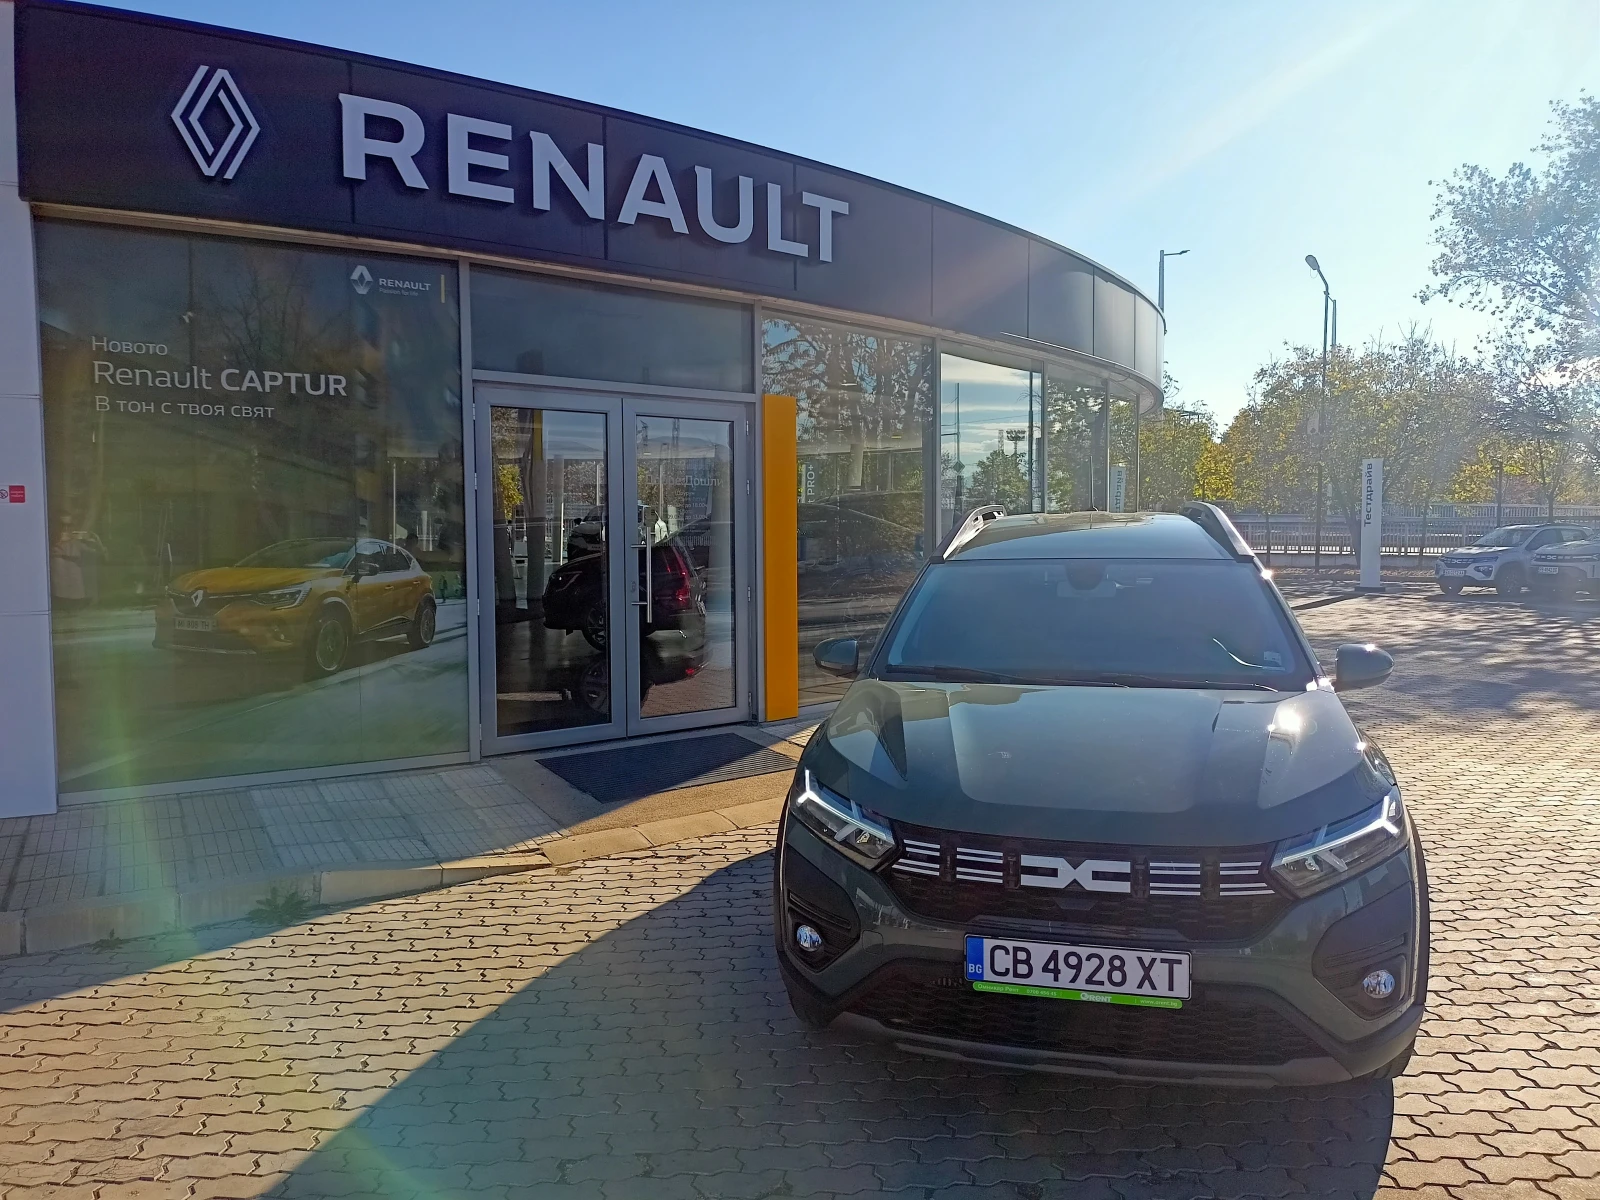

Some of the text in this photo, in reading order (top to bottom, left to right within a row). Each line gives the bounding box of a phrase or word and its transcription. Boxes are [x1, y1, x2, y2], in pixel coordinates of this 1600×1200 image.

[338, 92, 849, 263] RENAULT
[379, 278, 431, 291] RENAULT
[91, 336, 168, 356] Новото
[92, 360, 348, 397] Renault CAPTUR
[95, 395, 275, 419] В тон с твоя свят
[1363, 463, 1374, 528] Тестдрайв
[968, 963, 983, 974] BG
[989, 945, 1182, 992] CB 4928 XT
